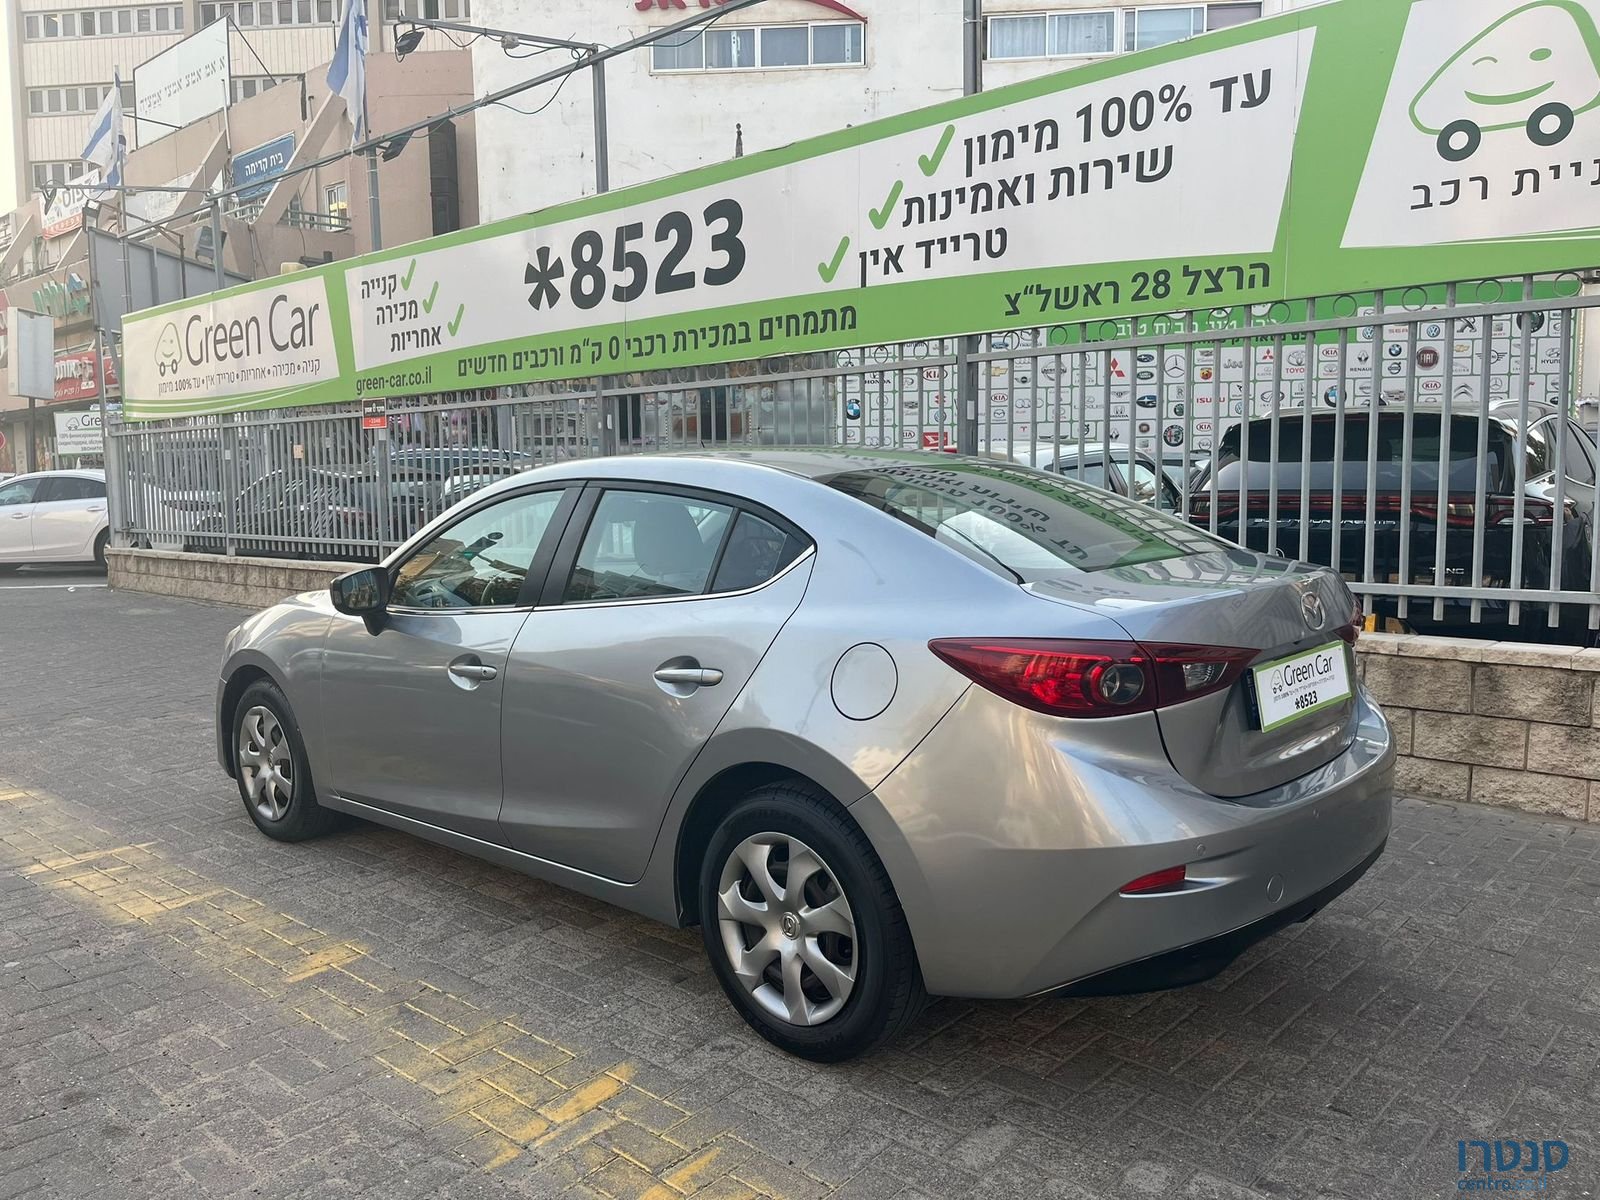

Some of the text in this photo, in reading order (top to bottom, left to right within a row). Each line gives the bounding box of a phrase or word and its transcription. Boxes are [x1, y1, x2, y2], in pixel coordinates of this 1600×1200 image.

[963, 68, 1272, 178] עד 100% מימון
[244, 152, 284, 177] בית קדימה
[902, 144, 1174, 228] שירות ואמינות
[1410, 175, 1489, 210] רכב
[858, 227, 1008, 288] טרייד אין
[361, 274, 397, 299] קנייה
[1131, 270, 1171, 303] 28
[1183, 262, 1271, 297] הרצל
[376, 299, 418, 326] מכירה
[759, 305, 857, 340] מתמחים
[186, 294, 320, 366] Green Car
[390, 326, 442, 352] אחריות
[673, 320, 751, 353] במכירת
[513, 344, 564, 370] ורכבים
[608, 335, 620, 360] 0
[626, 332, 666, 360] רכבי
[217, 371, 235, 385] טרייד
[240, 366, 266, 382] אחריות
[272, 362, 295, 377] מכירה
[302, 358, 320, 375] קניה
[458, 353, 507, 377] חדשים
[175, 378, 192, 392] 100%
[192, 376, 201, 389] עד
[205, 374, 215, 390] אין
[356, 366, 432, 395] green-car.co.il
[81, 414, 102, 427] Gre
[1429, 567, 1465, 575] TNG
[1284, 654, 1333, 687] Green Car
